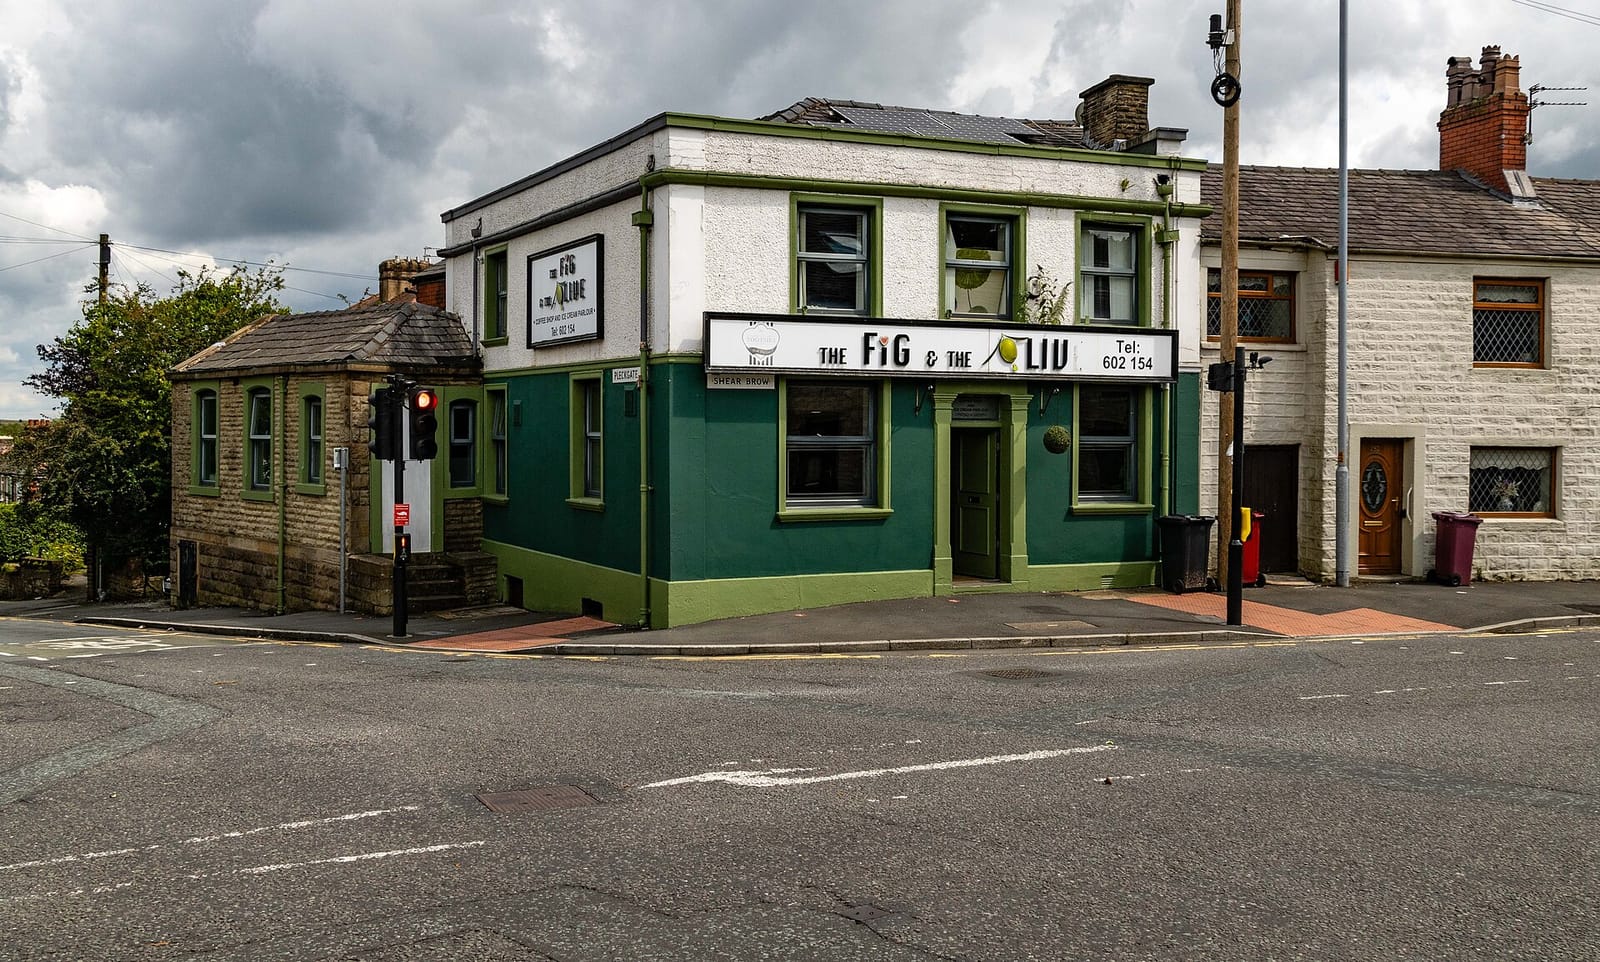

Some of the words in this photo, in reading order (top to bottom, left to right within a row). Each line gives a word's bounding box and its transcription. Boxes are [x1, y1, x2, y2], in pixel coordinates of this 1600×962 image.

[1116, 340, 1141, 354] Tel:
[819, 347, 847, 365] THE
[926, 350, 938, 367] &
[946, 350, 972, 368] THE
[1103, 355, 1126, 369] 602
[1130, 356, 1153, 370] 154
[713, 377, 742, 385] SHEAR
[746, 377, 769, 386] BROW
